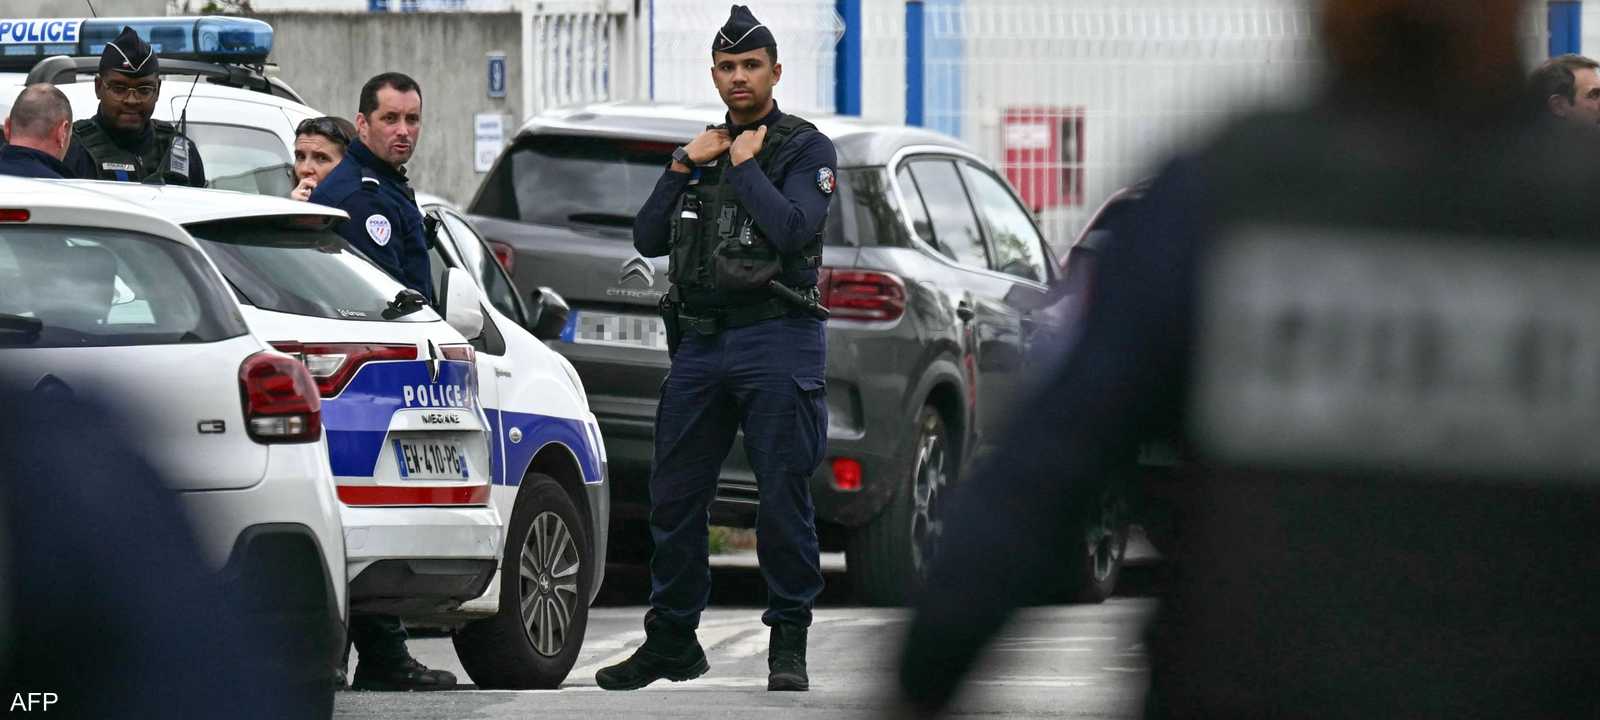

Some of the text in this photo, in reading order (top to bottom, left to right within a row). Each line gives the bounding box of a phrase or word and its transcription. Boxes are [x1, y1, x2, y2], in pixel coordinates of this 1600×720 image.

[0, 21, 77, 41] POLICE
[403, 384, 464, 407] POLICE
[197, 420, 225, 434] C3
